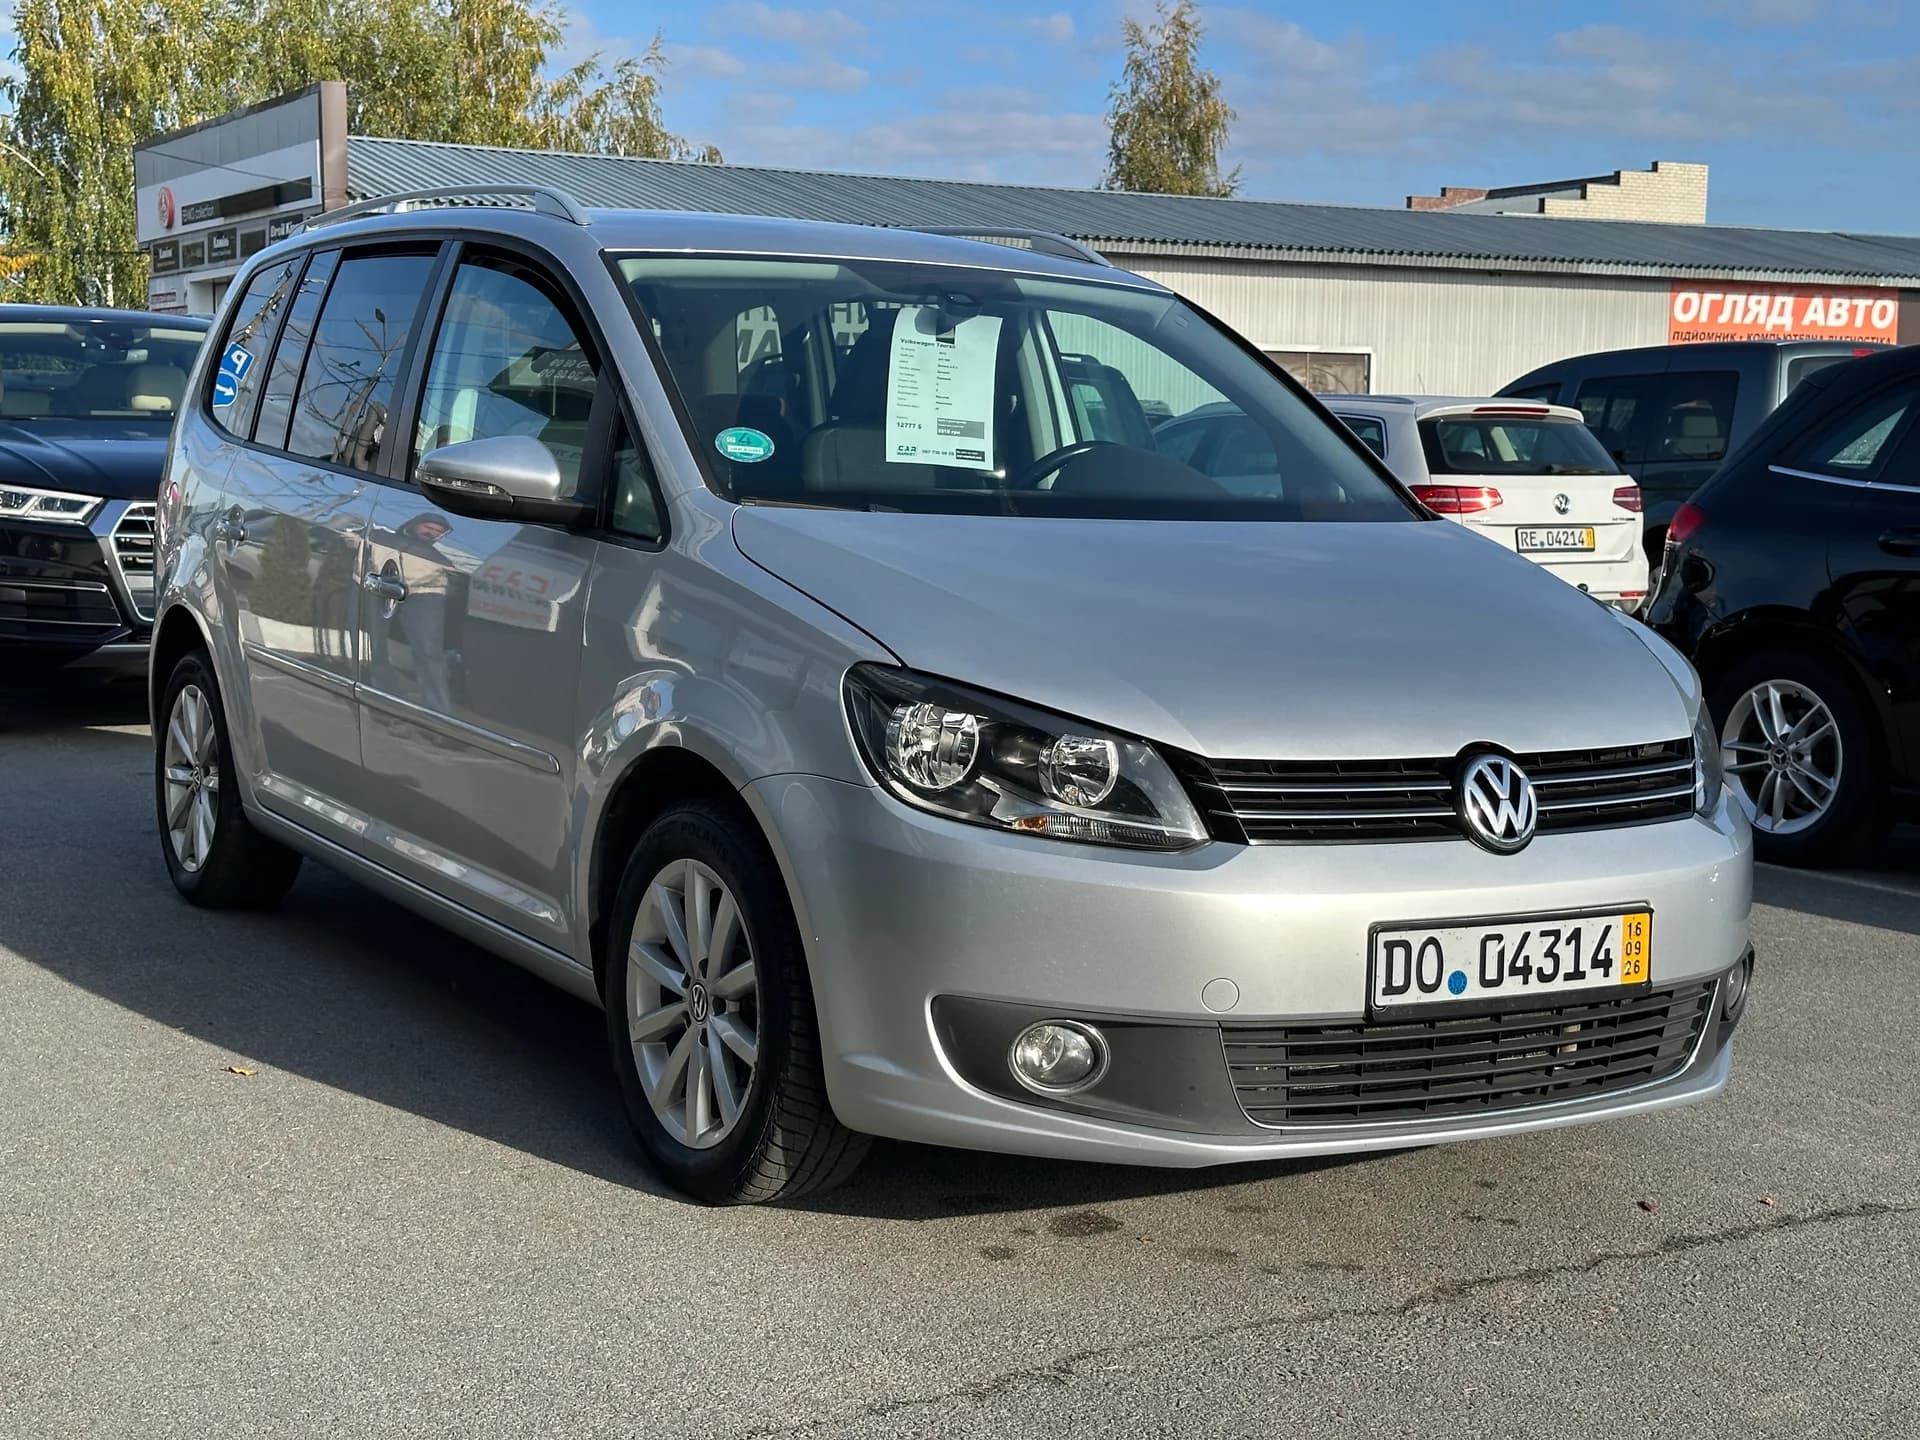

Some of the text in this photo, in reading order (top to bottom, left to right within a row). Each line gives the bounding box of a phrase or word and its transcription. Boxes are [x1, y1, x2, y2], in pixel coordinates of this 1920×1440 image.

[1673, 291, 1897, 331] ОГЛЯД АВТО
[900, 338, 935, 347] Volkswagen
[1672, 329, 1736, 342] ПІДЙОМНИК
[896, 421, 917, 430] 12777
[898, 444, 917, 452] CAR
[1519, 531, 1537, 547] RE
[1546, 530, 1585, 547] 04214
[1627, 921, 1642, 939] 16
[1624, 940, 1641, 956] 09
[1382, 924, 1613, 996] DO 04314
[1624, 959, 1641, 976] 26
